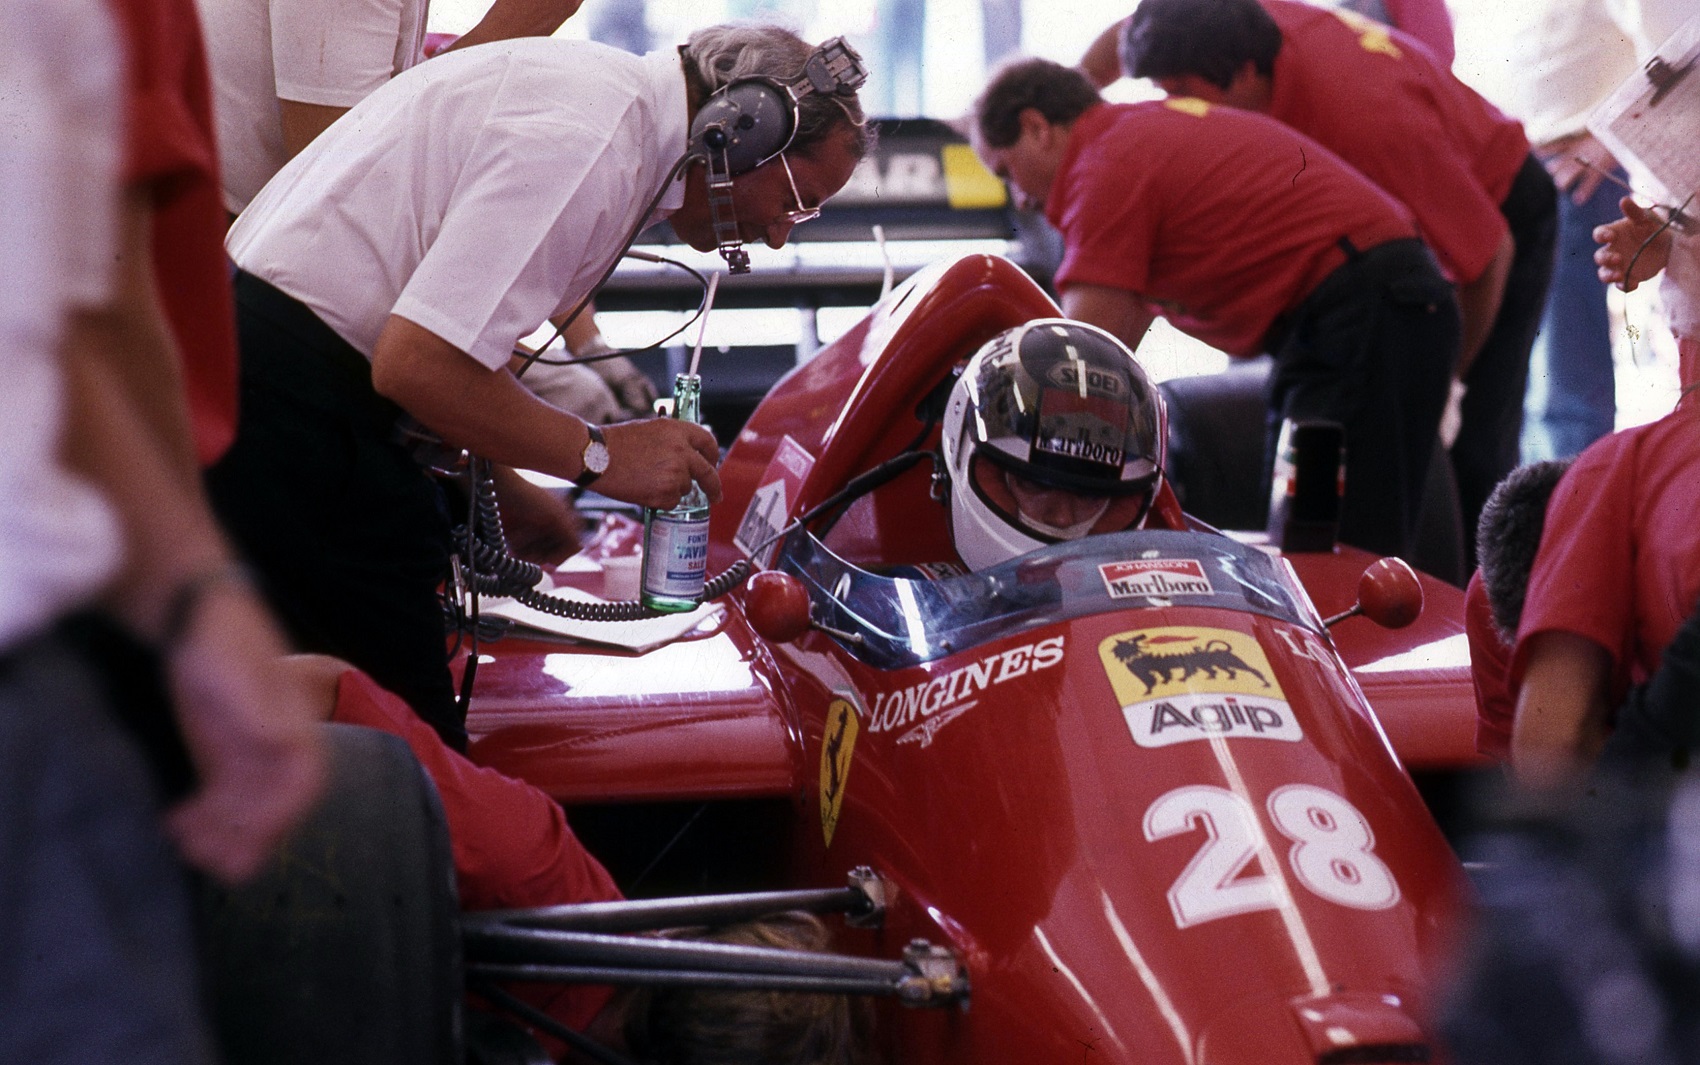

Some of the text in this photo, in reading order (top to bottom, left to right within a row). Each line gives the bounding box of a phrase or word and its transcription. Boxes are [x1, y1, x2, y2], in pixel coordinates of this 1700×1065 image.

[1111, 574, 1210, 596] Marlboro
[868, 635, 1065, 733] LONGINES
[1150, 697, 1283, 735] Agip
[1141, 783, 1401, 930] 28
